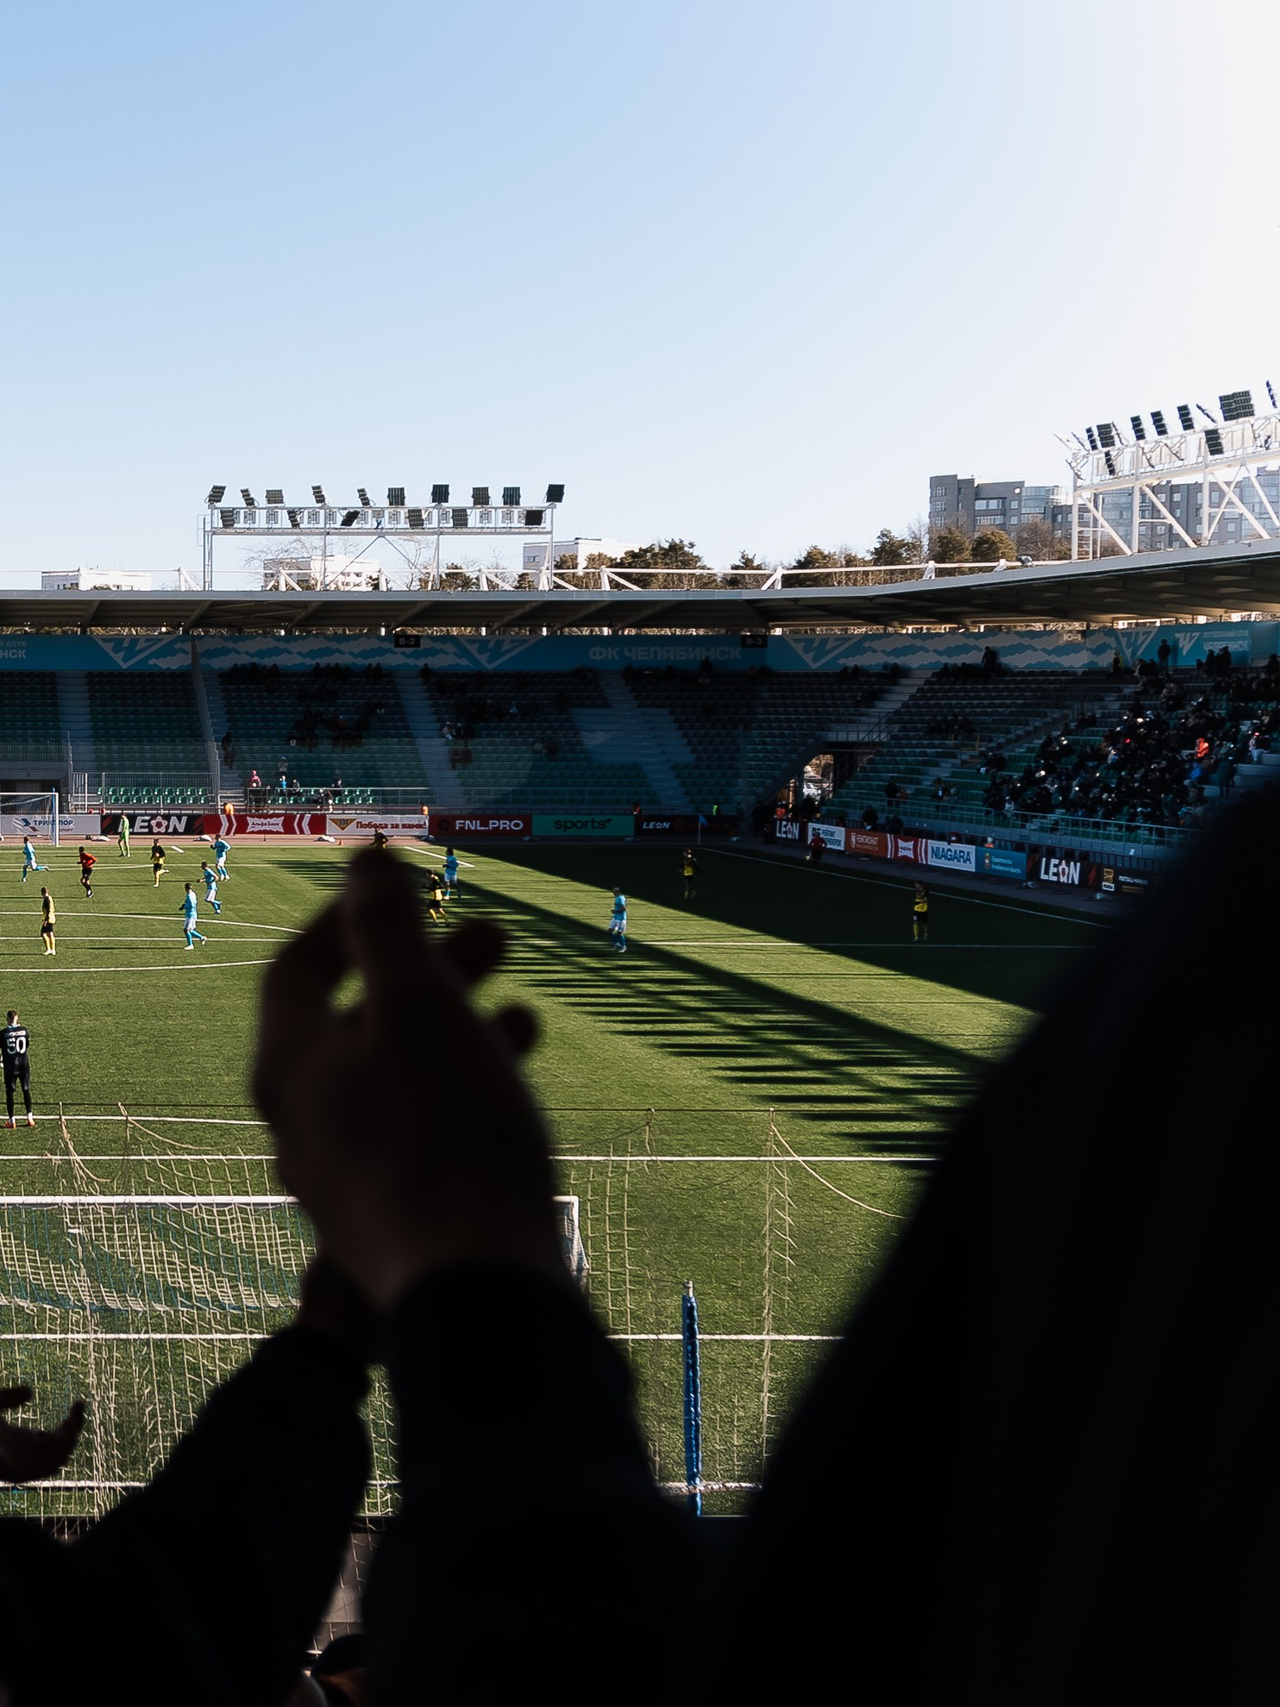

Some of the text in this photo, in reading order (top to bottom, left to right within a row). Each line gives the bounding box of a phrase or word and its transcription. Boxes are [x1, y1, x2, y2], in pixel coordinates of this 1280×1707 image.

[588, 646, 743, 660] ФК ЧЕЛЯБИНСК
[355, 820, 389, 829] Победа
[455, 819, 524, 831] FNL.PRO
[642, 821, 671, 829] LEON
[776, 820, 800, 840] LEON
[931, 845, 972, 865] NIAGARA
[1040, 857, 1081, 885] LEON
[6, 1036, 27, 1055] 50
